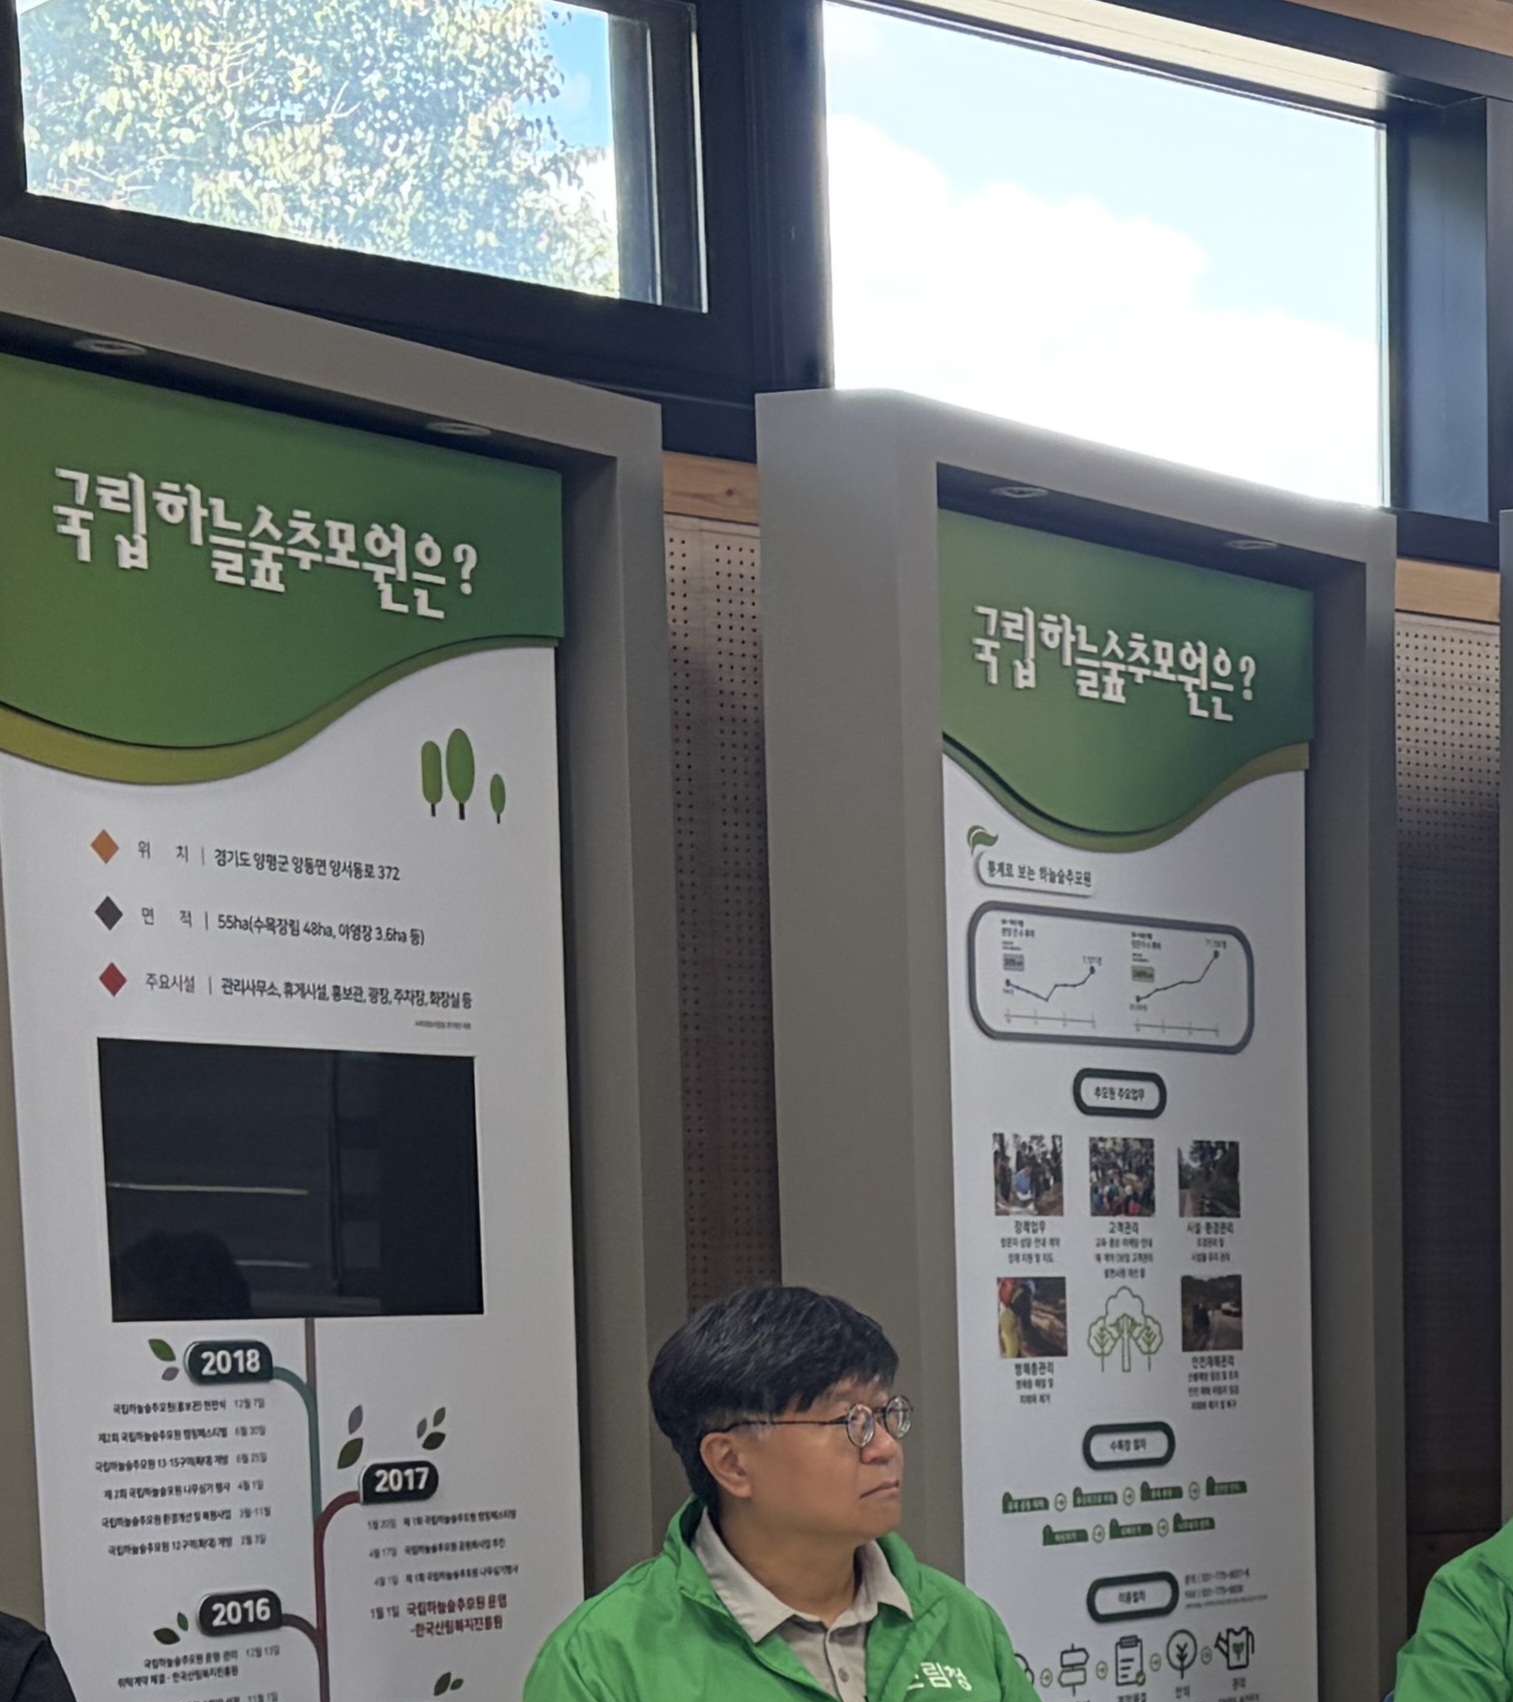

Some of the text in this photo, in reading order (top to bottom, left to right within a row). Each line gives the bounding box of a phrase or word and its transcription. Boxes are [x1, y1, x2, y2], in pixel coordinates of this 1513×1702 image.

[53, 467, 478, 620] 국립하늘숲추모원은?
[972, 605, 1256, 721] 국립하늘숲추모원은?
[138, 840, 151, 859] 위
[176, 845, 188, 862] 치
[214, 849, 251, 867] 경기도
[253, 852, 289, 872] 양평군
[292, 856, 327, 876] 양동면
[378, 865, 400, 881] 372
[1017, 864, 1036, 881] 보는
[1039, 866, 1091, 888] 하늘숲추모원
[141, 907, 154, 925] 면
[179, 910, 192, 928] 적
[410, 928, 425, 946] 등)
[145, 973, 195, 993] 주요시설
[221, 978, 281, 998] 관리사무소,
[201, 1349, 261, 1377] 2018
[375, 1467, 429, 1492] 2017
[212, 1598, 271, 1627] 2016
